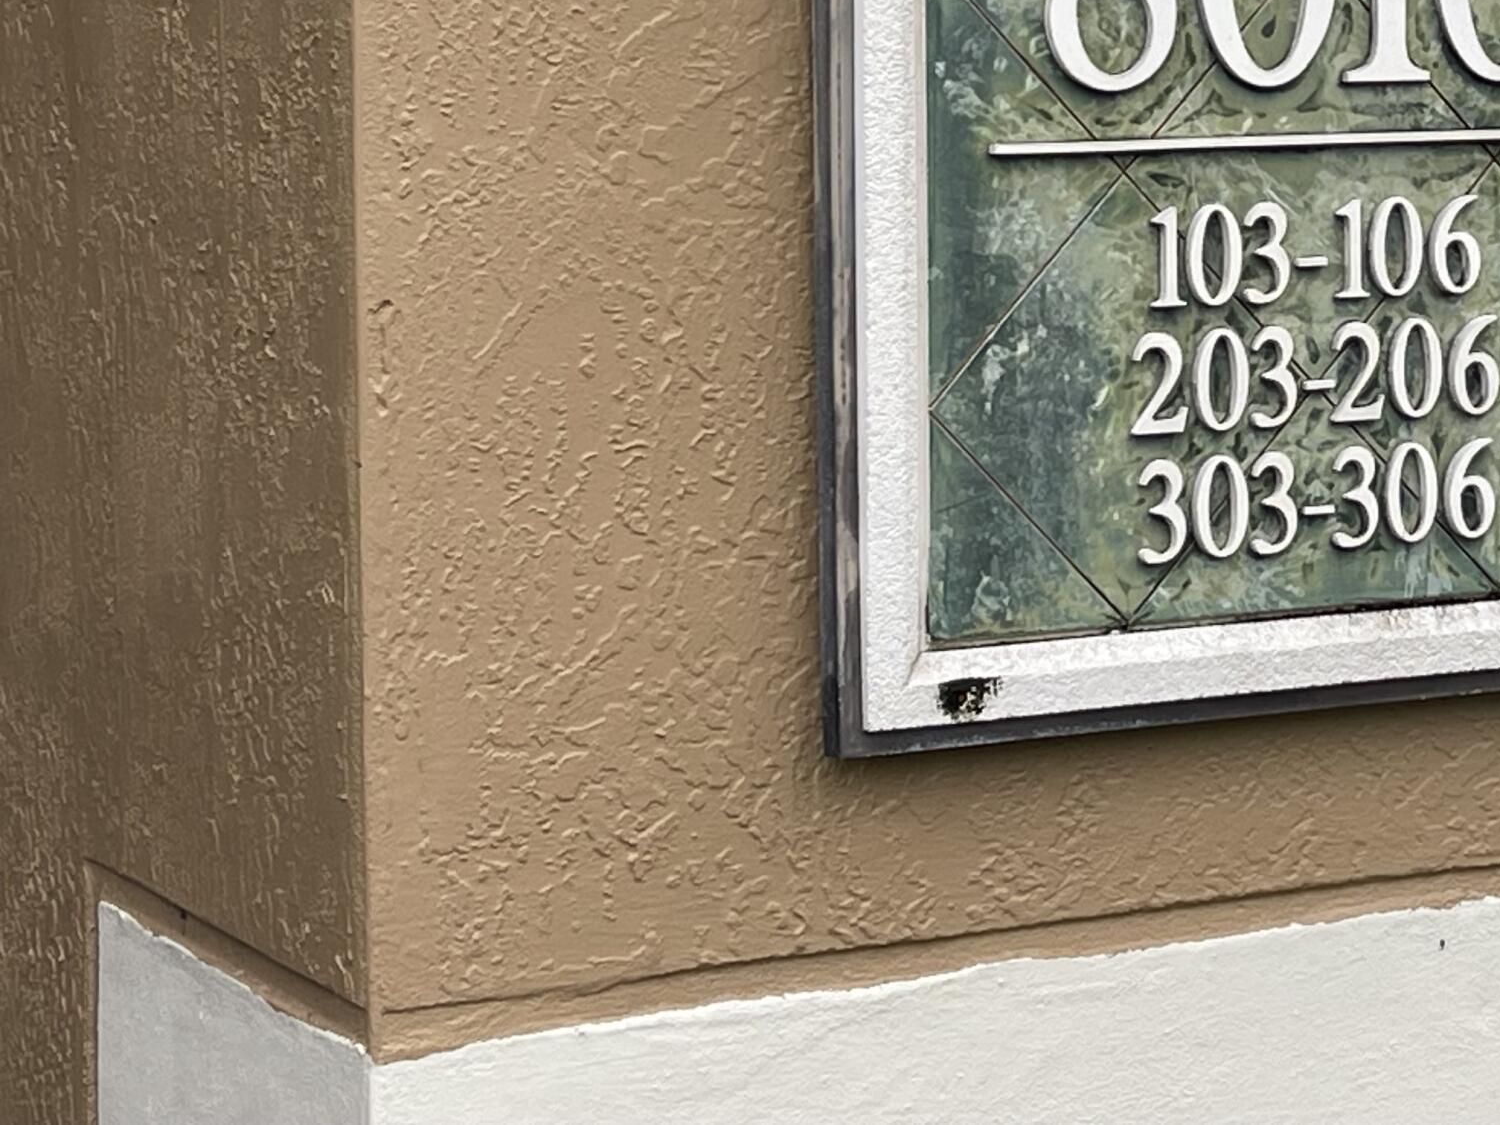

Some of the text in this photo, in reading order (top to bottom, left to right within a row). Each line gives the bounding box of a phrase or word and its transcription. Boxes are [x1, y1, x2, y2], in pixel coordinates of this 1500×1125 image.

[1150, 195, 1481, 308] 103-106
[1131, 314, 1500, 436] 203-206
[1137, 437, 1496, 565] 303-306
